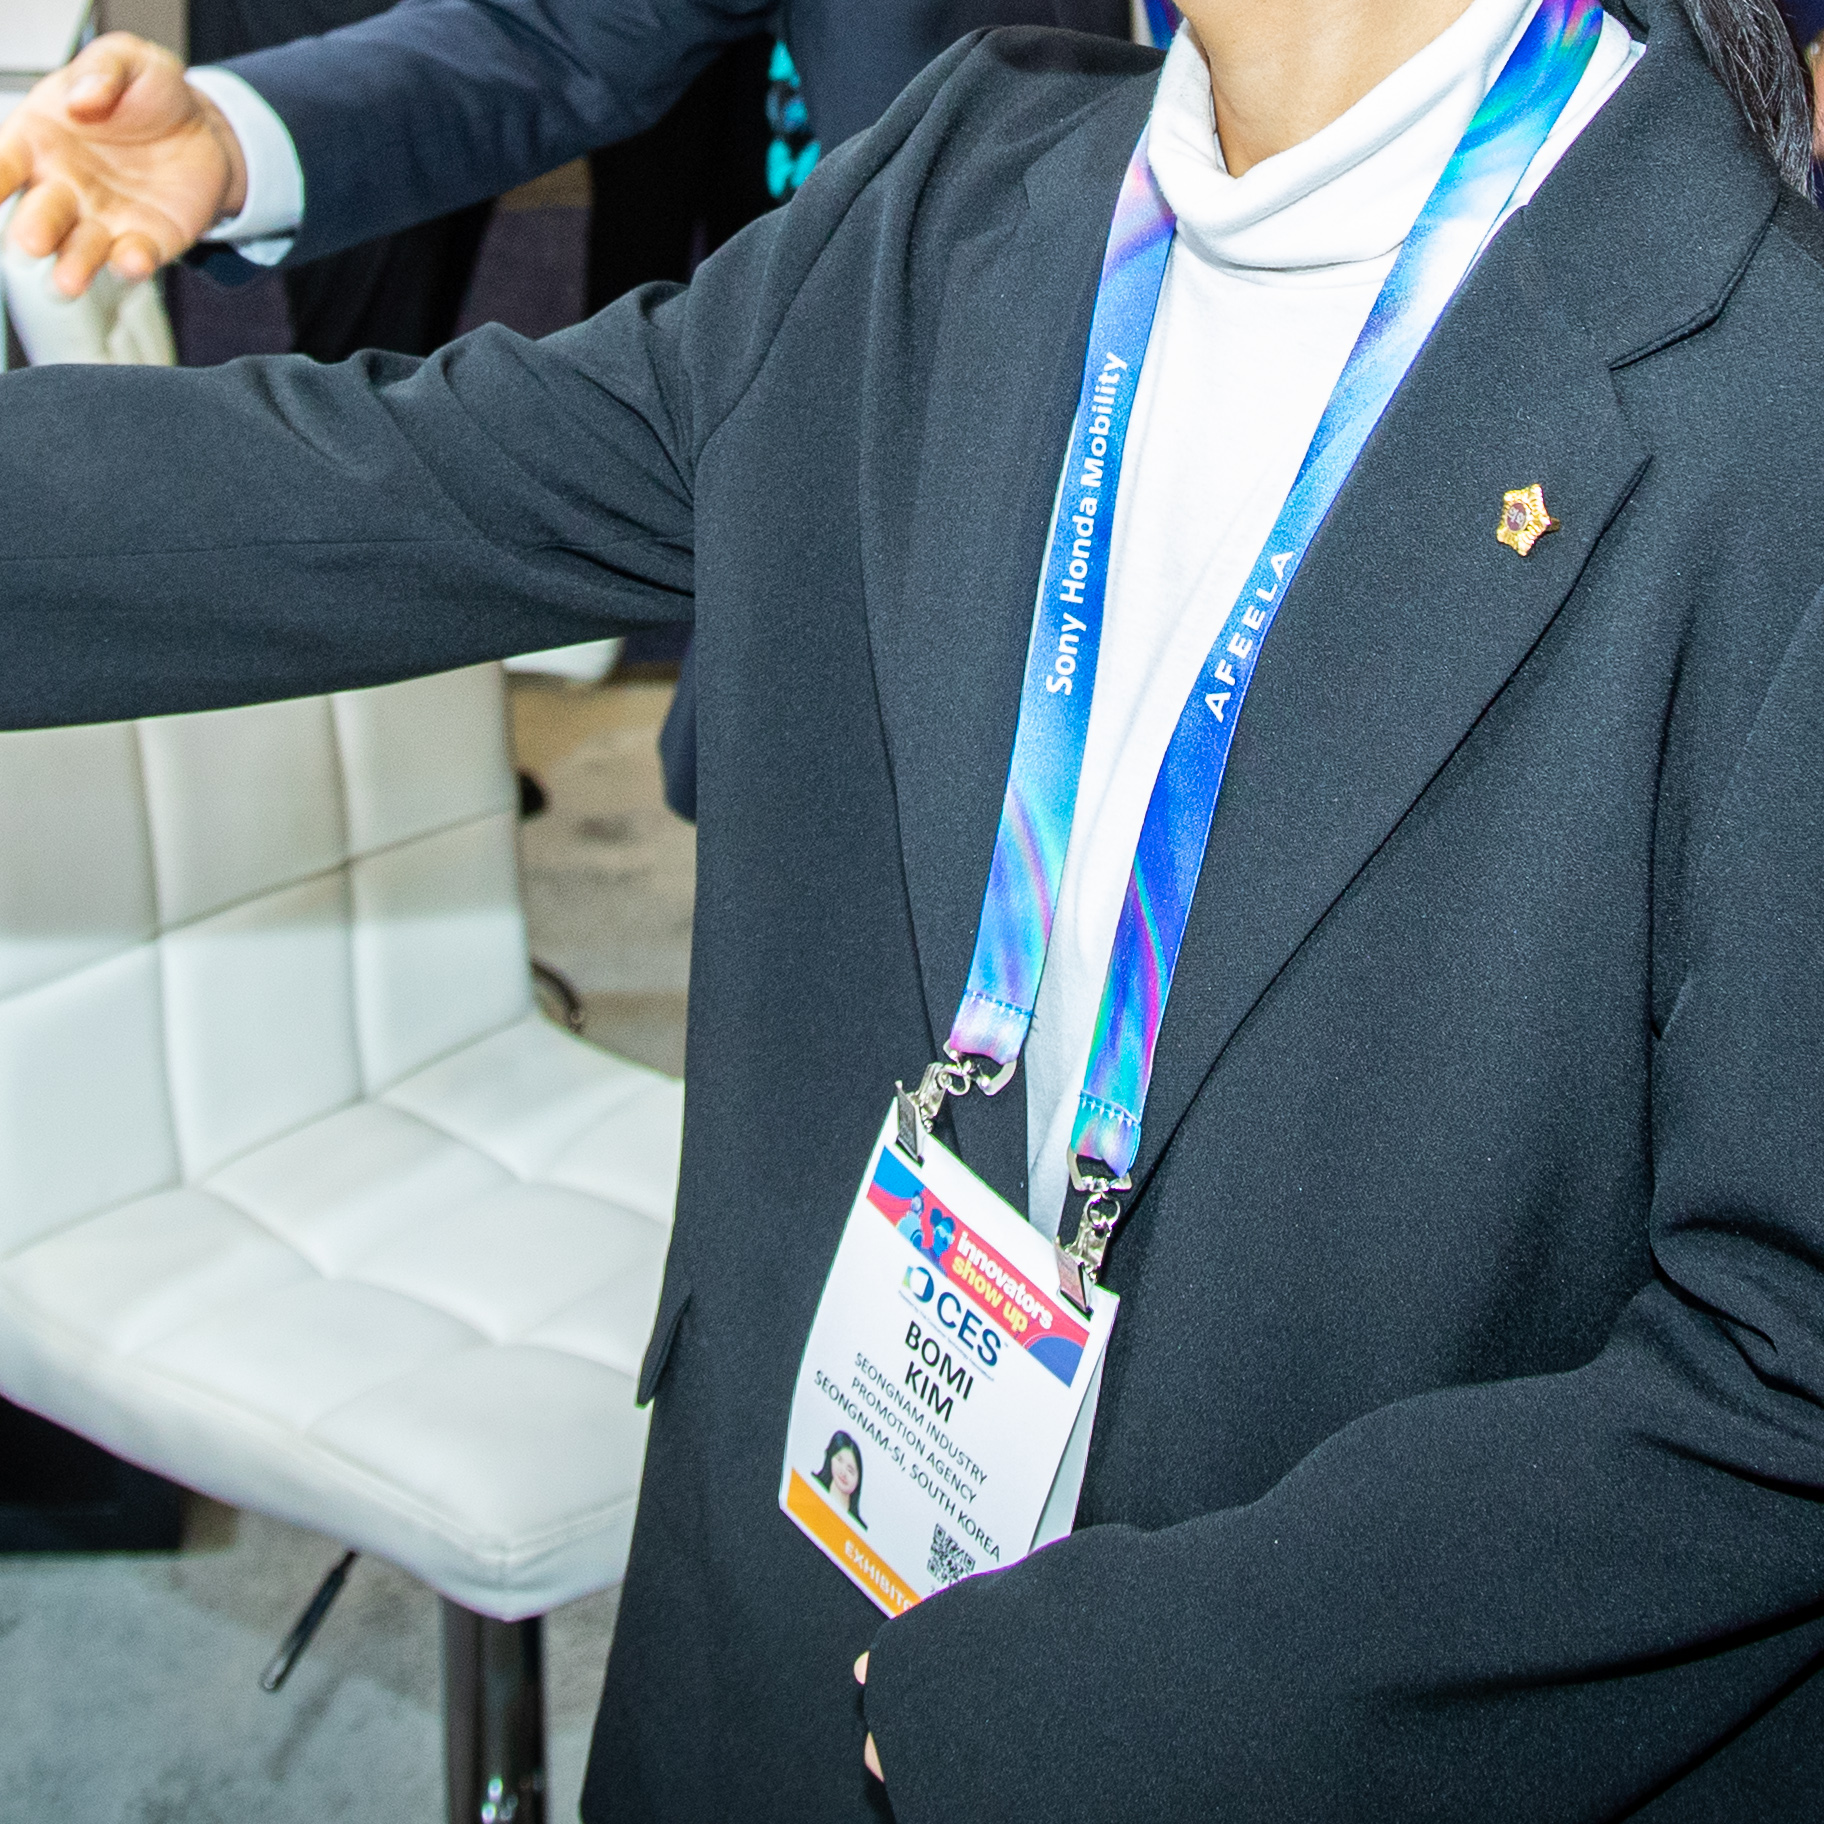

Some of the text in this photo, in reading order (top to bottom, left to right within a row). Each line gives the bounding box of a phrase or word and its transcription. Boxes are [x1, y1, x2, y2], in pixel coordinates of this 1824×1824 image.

[1045, 351, 1129, 697] Sony Honda Mobility
[1203, 549, 1295, 724] AFEELA
[936, 1291, 1002, 1367] CES
[952, 1255, 1029, 1333] show up
[956, 1231, 1054, 1330] innovators
[904, 1320, 974, 1400] BOMI
[904, 1360, 954, 1423] KIM
[814, 1370, 1002, 1564] SEONGNAM-SI, SOUTH KOREA
[850, 1375, 978, 1505] PROMOTION AGENCY
[853, 1351, 988, 1486] SEONGNAM INDUSTRY
